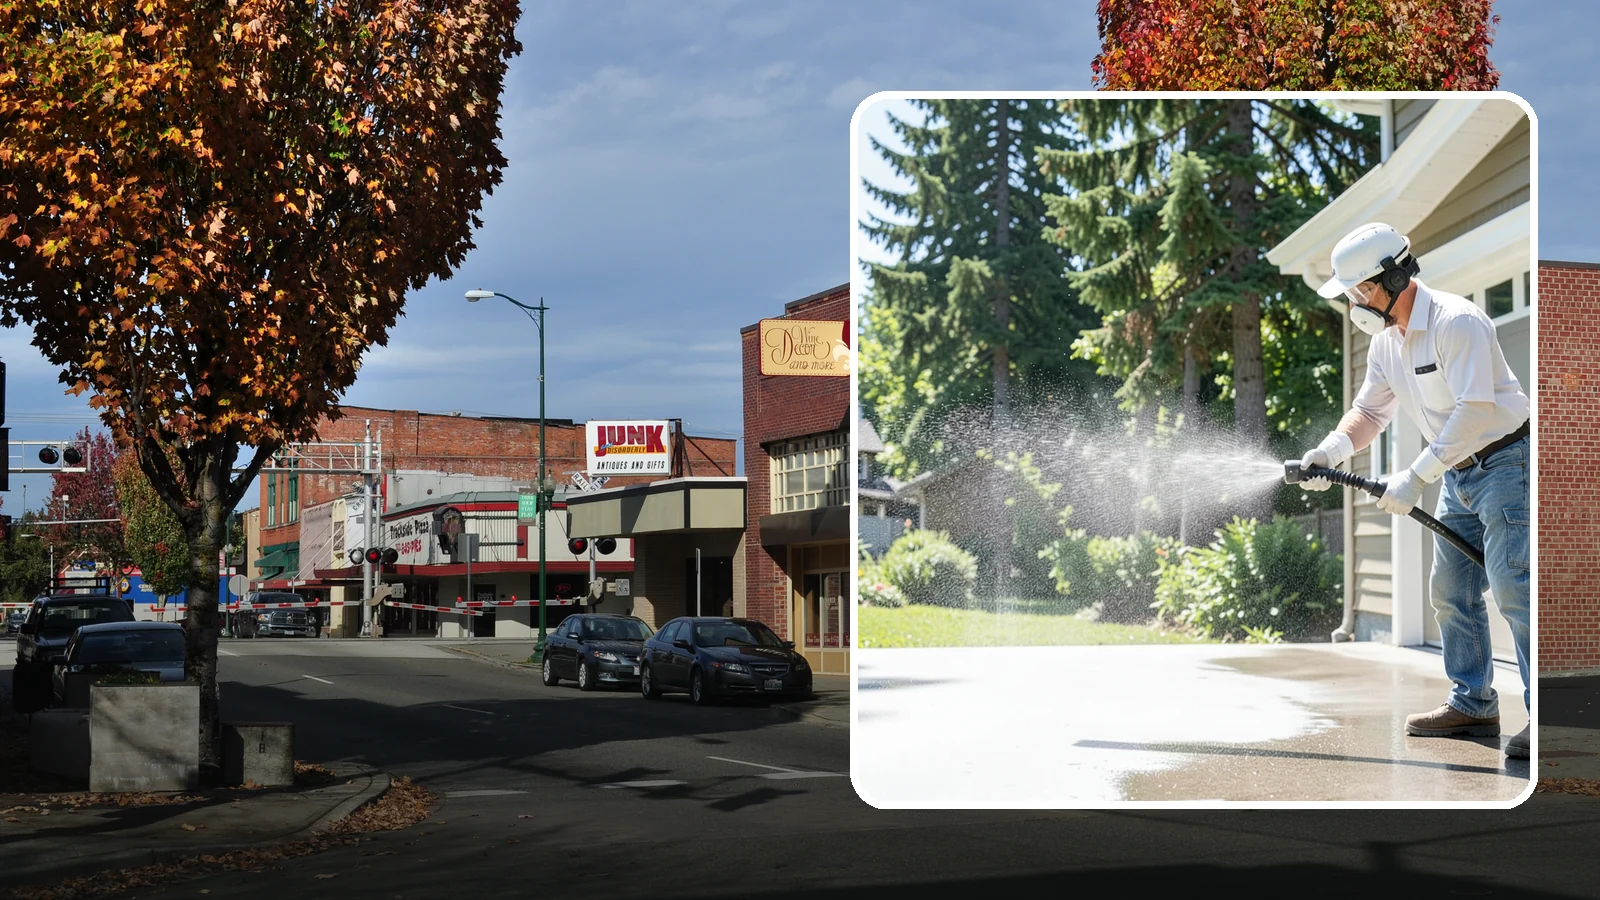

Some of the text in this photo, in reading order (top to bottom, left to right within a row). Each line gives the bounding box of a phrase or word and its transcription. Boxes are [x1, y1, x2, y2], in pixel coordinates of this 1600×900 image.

[595, 425, 665, 457] JUNK
[608, 446, 646, 454] DISORDERLY
[597, 460, 665, 470] ANTIQUES AND GIFTS
[390, 519, 429, 539] Trackside Pizza
